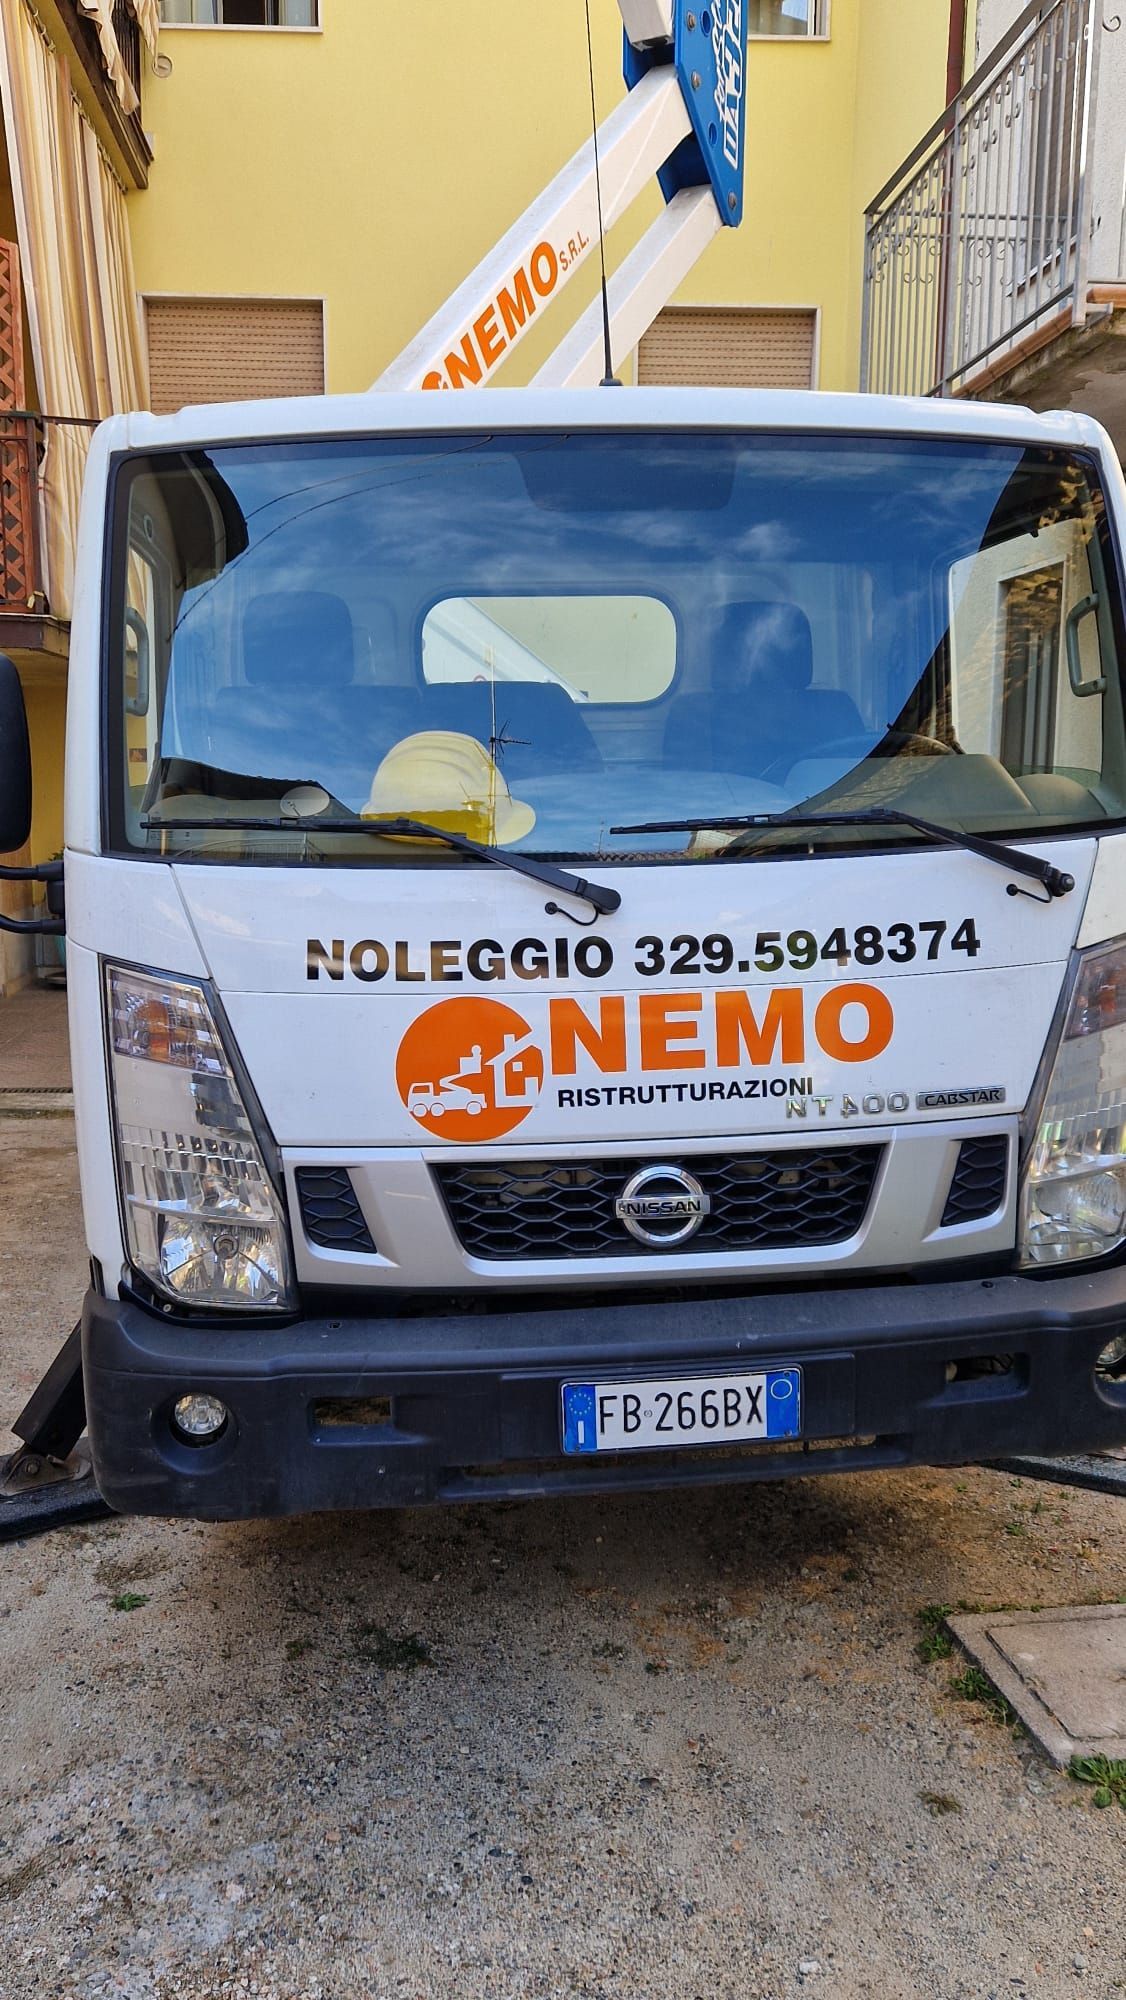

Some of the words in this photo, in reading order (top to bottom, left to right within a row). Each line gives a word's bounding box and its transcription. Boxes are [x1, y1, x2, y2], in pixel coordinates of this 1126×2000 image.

[443, 241, 558, 388] NEMO
[559, 231, 590, 271] S.R.L.
[306, 936, 614, 982] NOLEGGIO
[634, 918, 981, 976] 329.5948374
[549, 983, 894, 1075] NEMO
[558, 1077, 813, 1107] RISTRUTTURAZIONI
[925, 1089, 1001, 1106] CABSTAR
[626, 1200, 701, 1214] NISSAN
